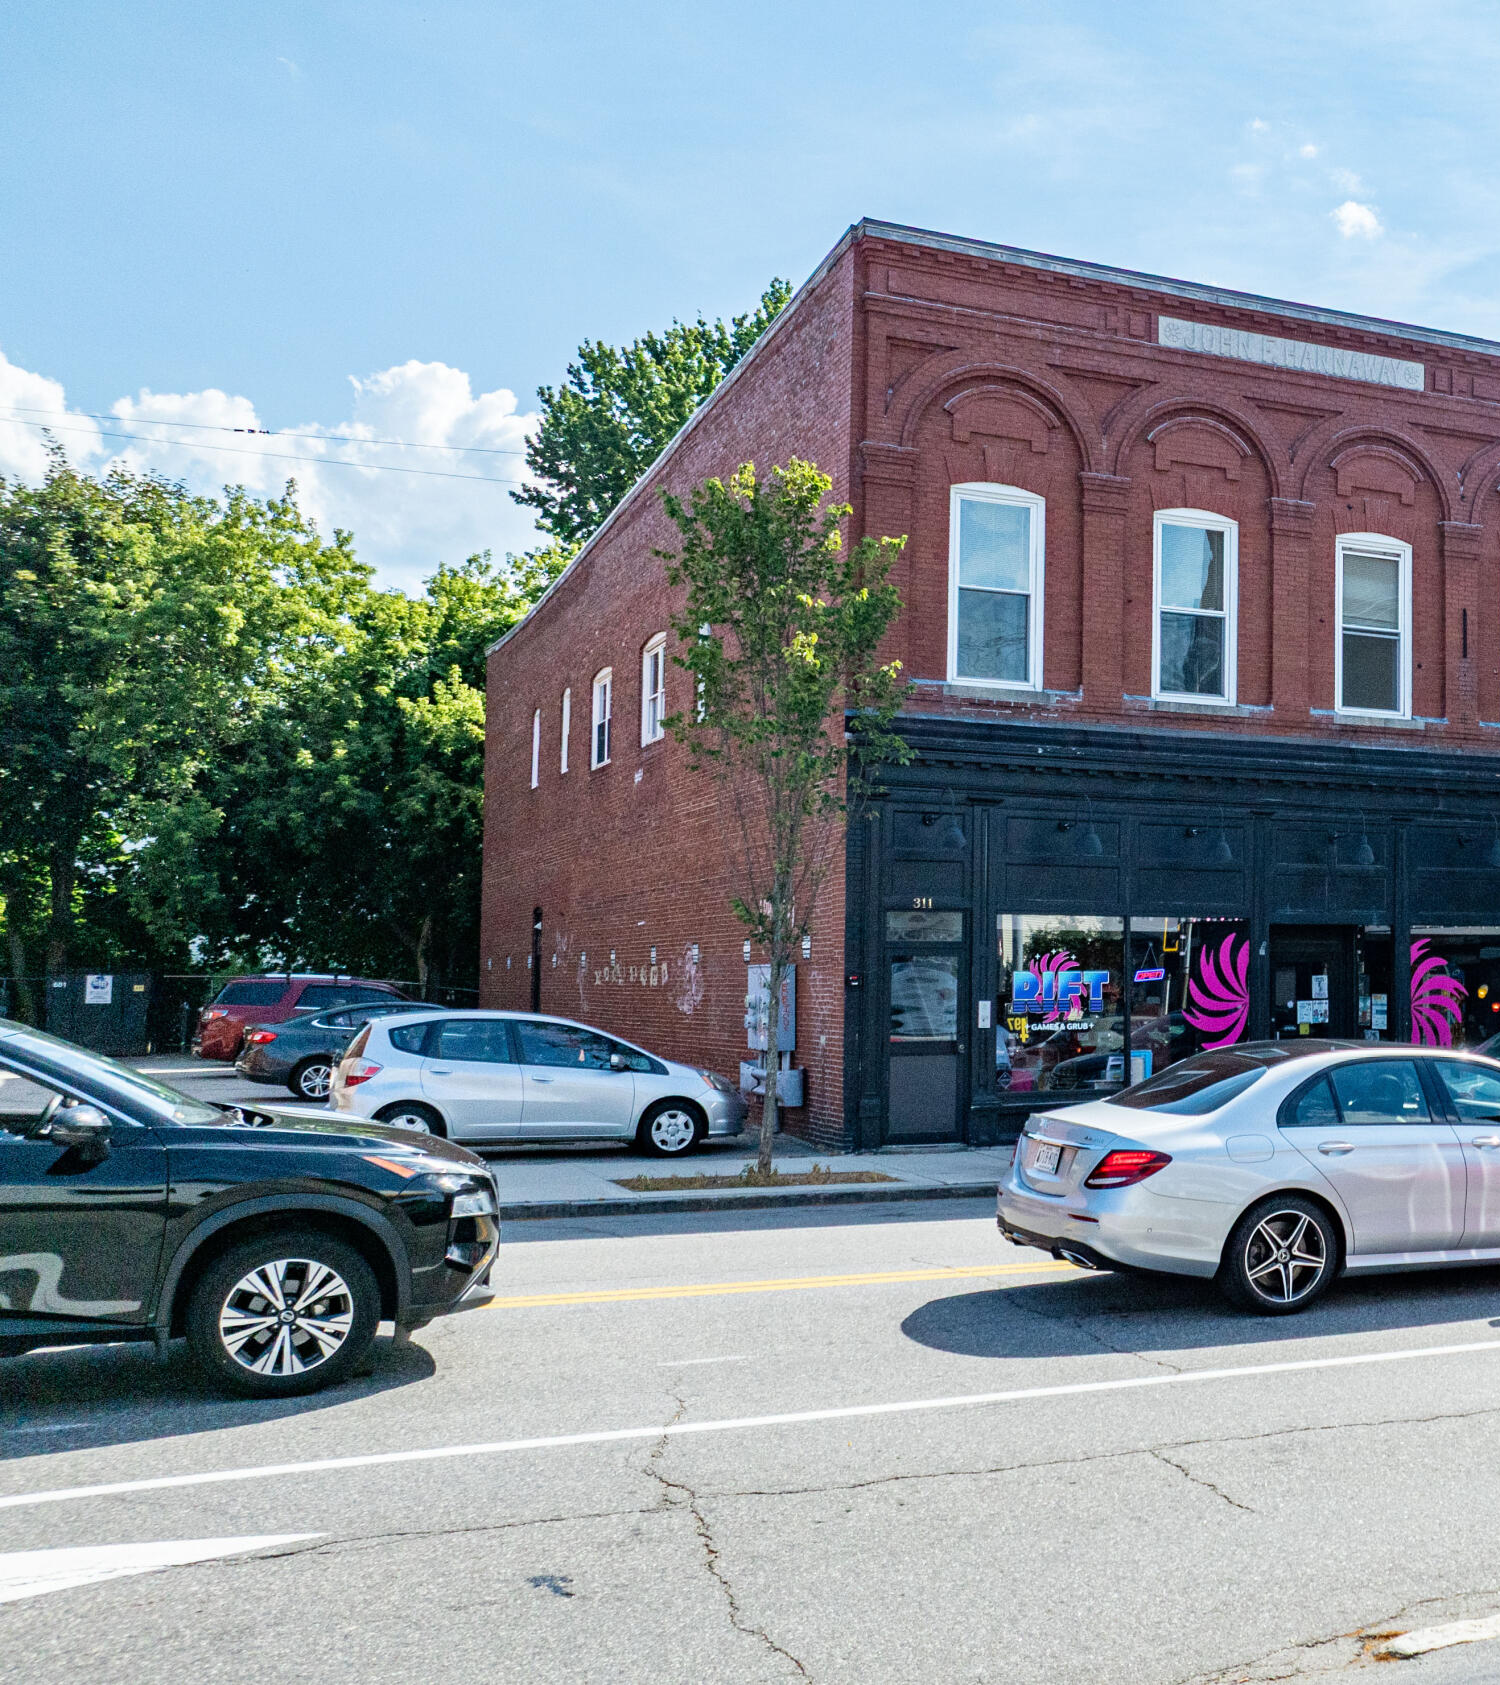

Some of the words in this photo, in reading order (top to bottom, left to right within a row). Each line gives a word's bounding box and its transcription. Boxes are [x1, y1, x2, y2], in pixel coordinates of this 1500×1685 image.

[1183, 321, 1251, 360] JOHN
[913, 897, 932, 909] 311
[1012, 970, 1110, 1013] RIFT
[1031, 1023, 1057, 1031] GAMES
[1066, 1022, 1088, 1030] GRUB
